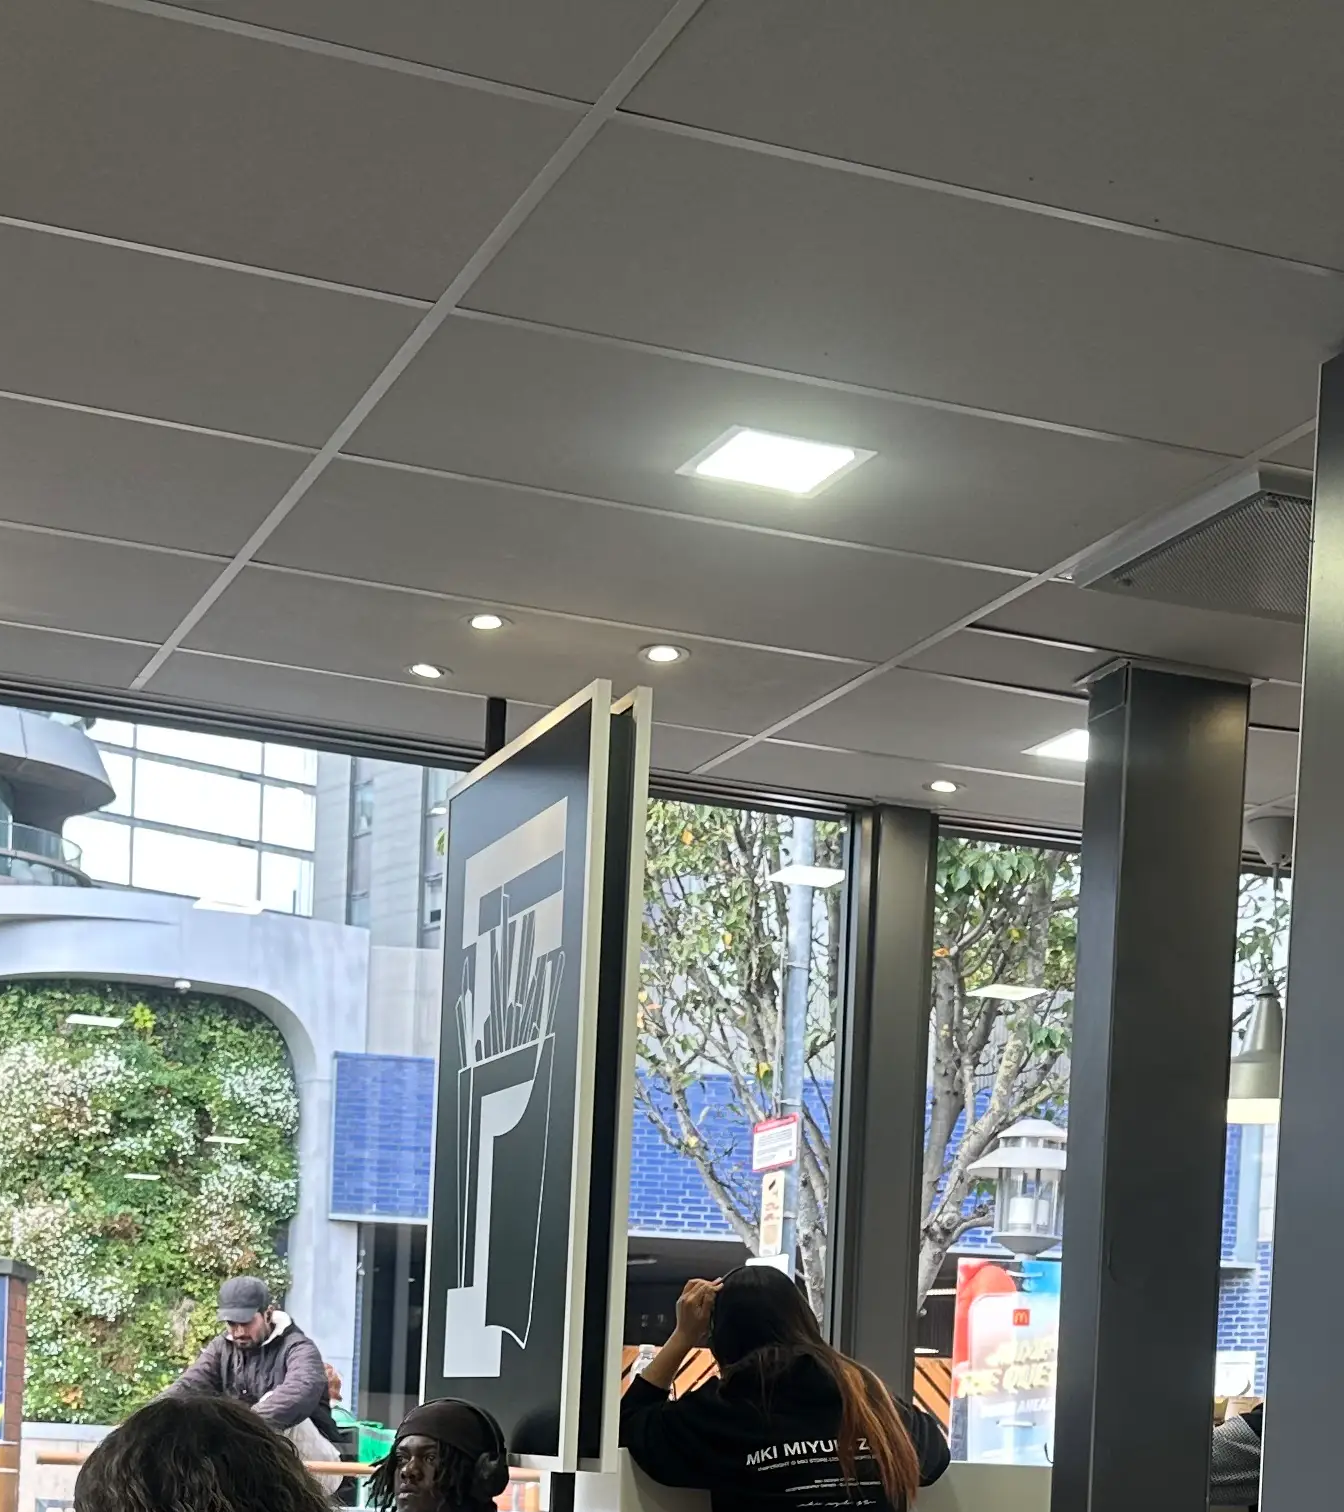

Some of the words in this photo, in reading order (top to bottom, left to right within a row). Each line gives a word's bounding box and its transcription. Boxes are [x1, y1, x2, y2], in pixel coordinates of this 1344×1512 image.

[1002, 1360, 1055, 1393] QUE
[746, 1446, 778, 1466] MKI
[783, 1439, 840, 1457] MIYU
